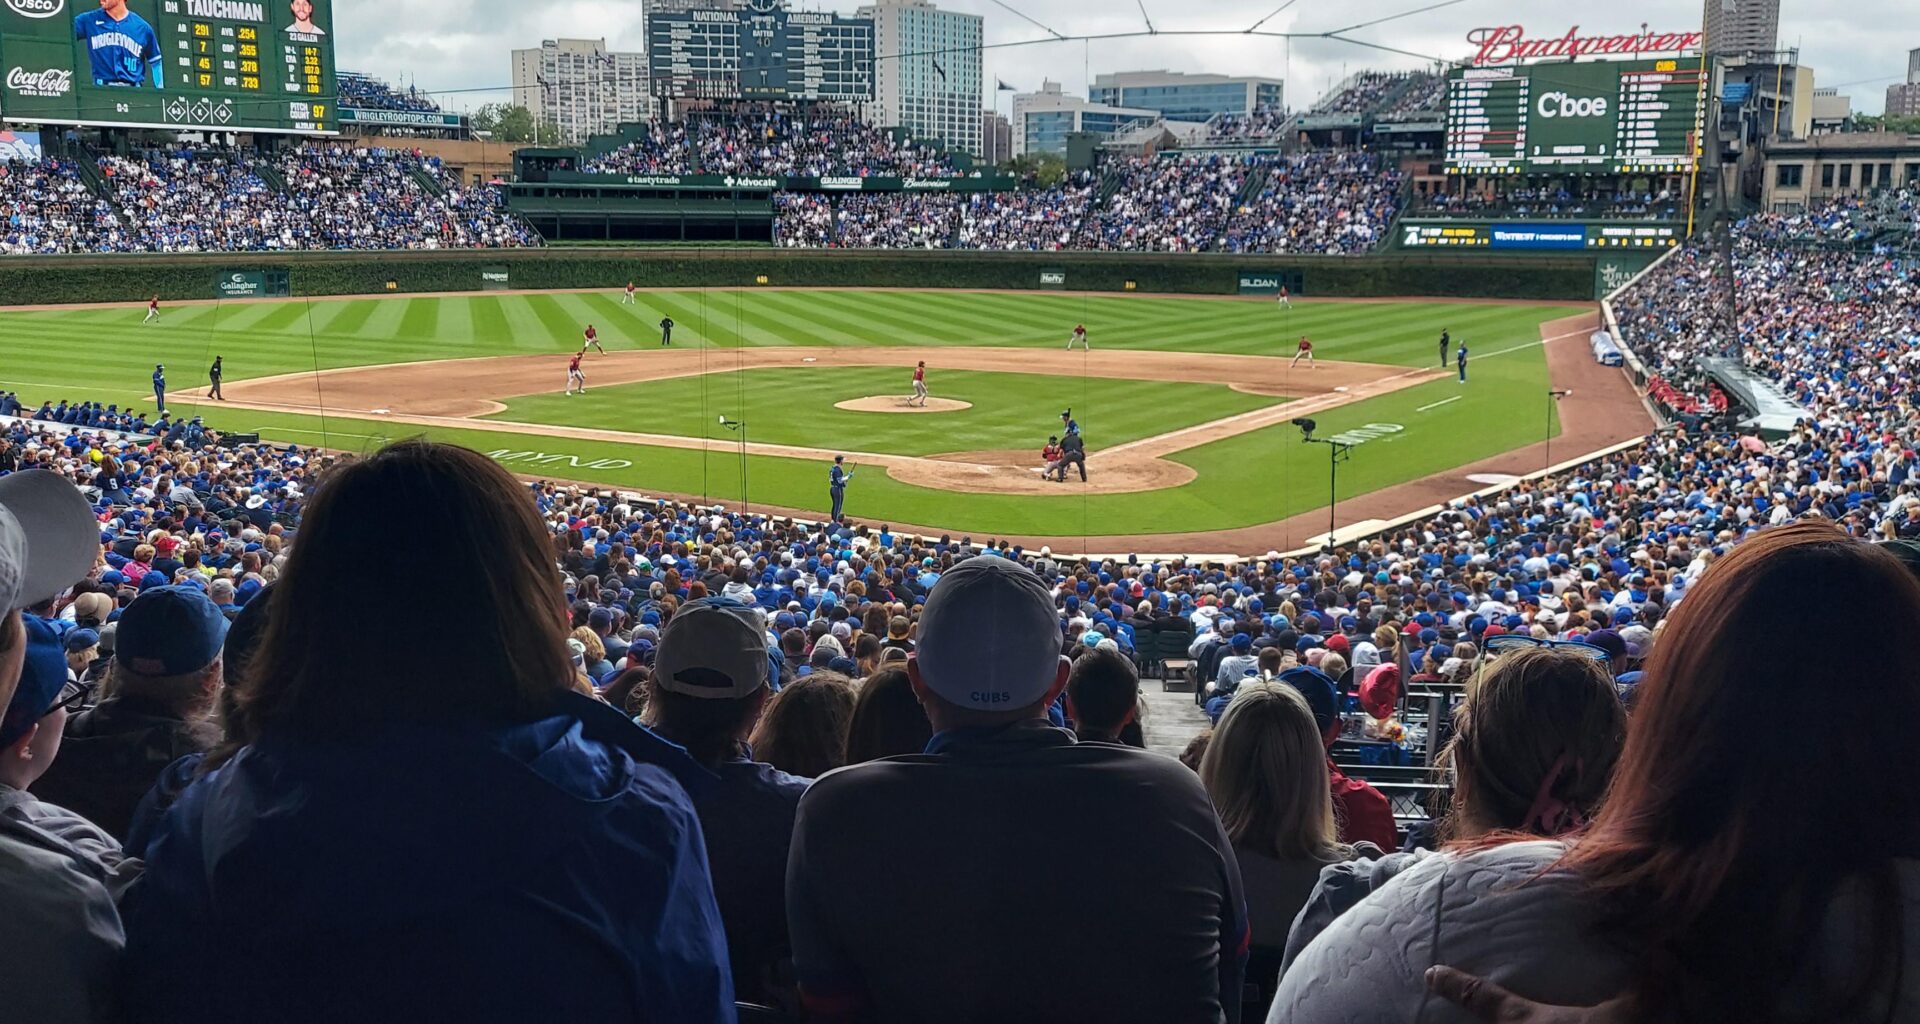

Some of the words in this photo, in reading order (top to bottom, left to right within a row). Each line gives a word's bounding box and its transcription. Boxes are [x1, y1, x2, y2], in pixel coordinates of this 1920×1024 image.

[165, 1, 179, 14] DH
[185, 0, 264, 22] TAUCHMAN
[692, 11, 740, 22] NATIONAL
[786, 13, 833, 25] AMERICAN
[195, 24, 209, 36] 291
[91, 31, 143, 58] WRIGLEYVILLE
[200, 41, 206, 53] 7
[1467, 25, 1703, 65] Budweiser
[124, 56, 138, 72] 40
[199, 57, 211, 70] 45
[6, 66, 73, 92] Coca-Cola
[200, 74, 211, 86] 57
[290, 101, 308, 111] PITCH
[313, 104, 325, 118] 97
[290, 110, 310, 120] COUNT
[353, 109, 444, 124] WRIGLEYROOFTOPS.COM
[633, 176, 680, 186] tastytrade
[736, 177, 777, 187] Advocate
[820, 177, 863, 185] GRAINGER
[902, 177, 950, 188] Budweiser
[220, 282, 258, 290] Gallagher
[1240, 279, 1278, 287] SLOAN
[485, 449, 633, 470] MYND
[970, 691, 1010, 703] CUBS
